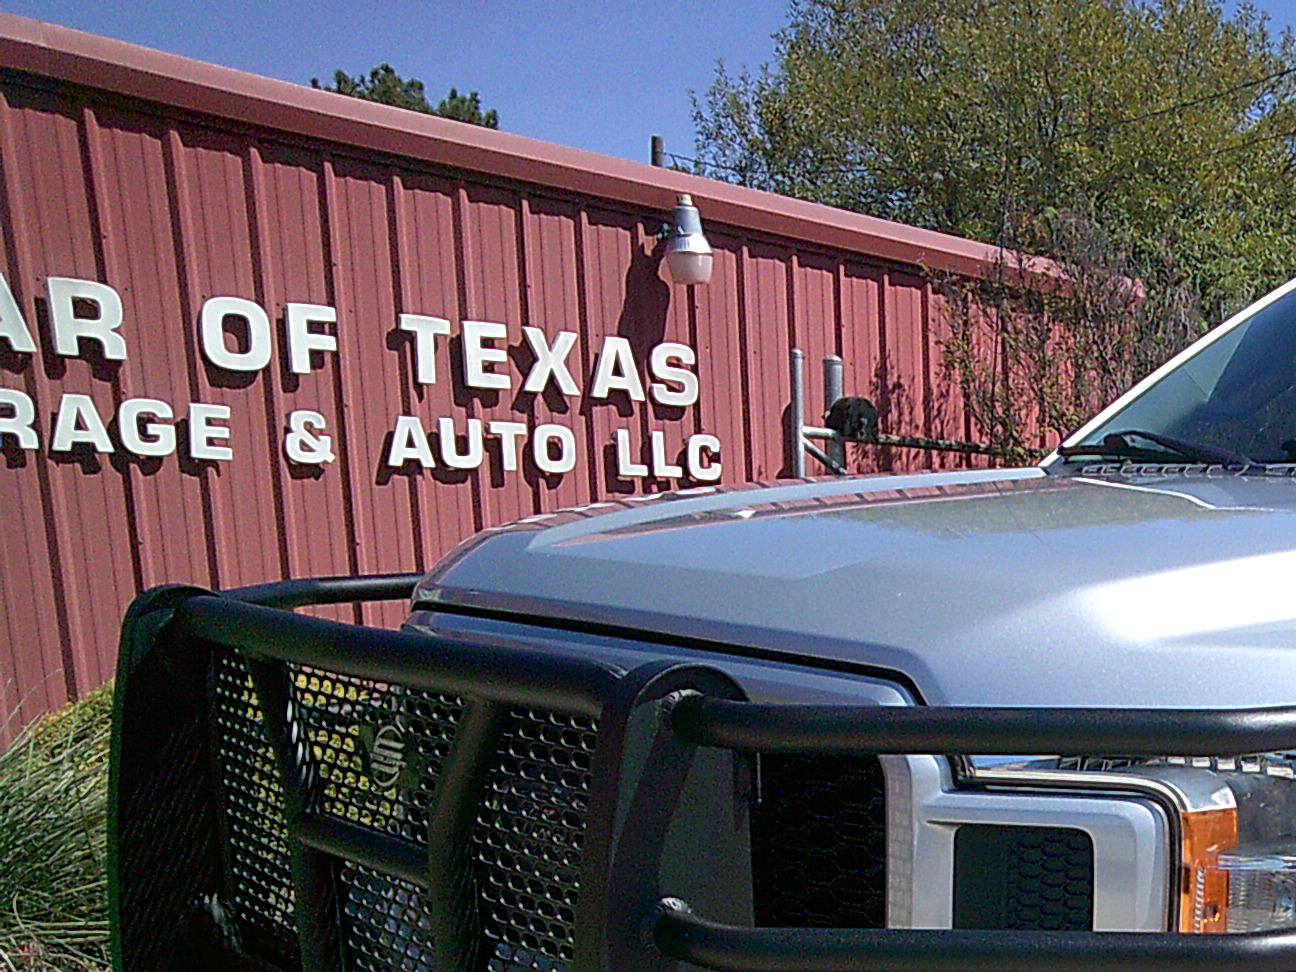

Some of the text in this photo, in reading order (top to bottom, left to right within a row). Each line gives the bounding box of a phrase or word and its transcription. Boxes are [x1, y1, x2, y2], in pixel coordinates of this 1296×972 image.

[201, 297, 337, 374] OF
[399, 313, 699, 407] TEXAS
[0, 388, 723, 482] RAGE & AUTO LLC
